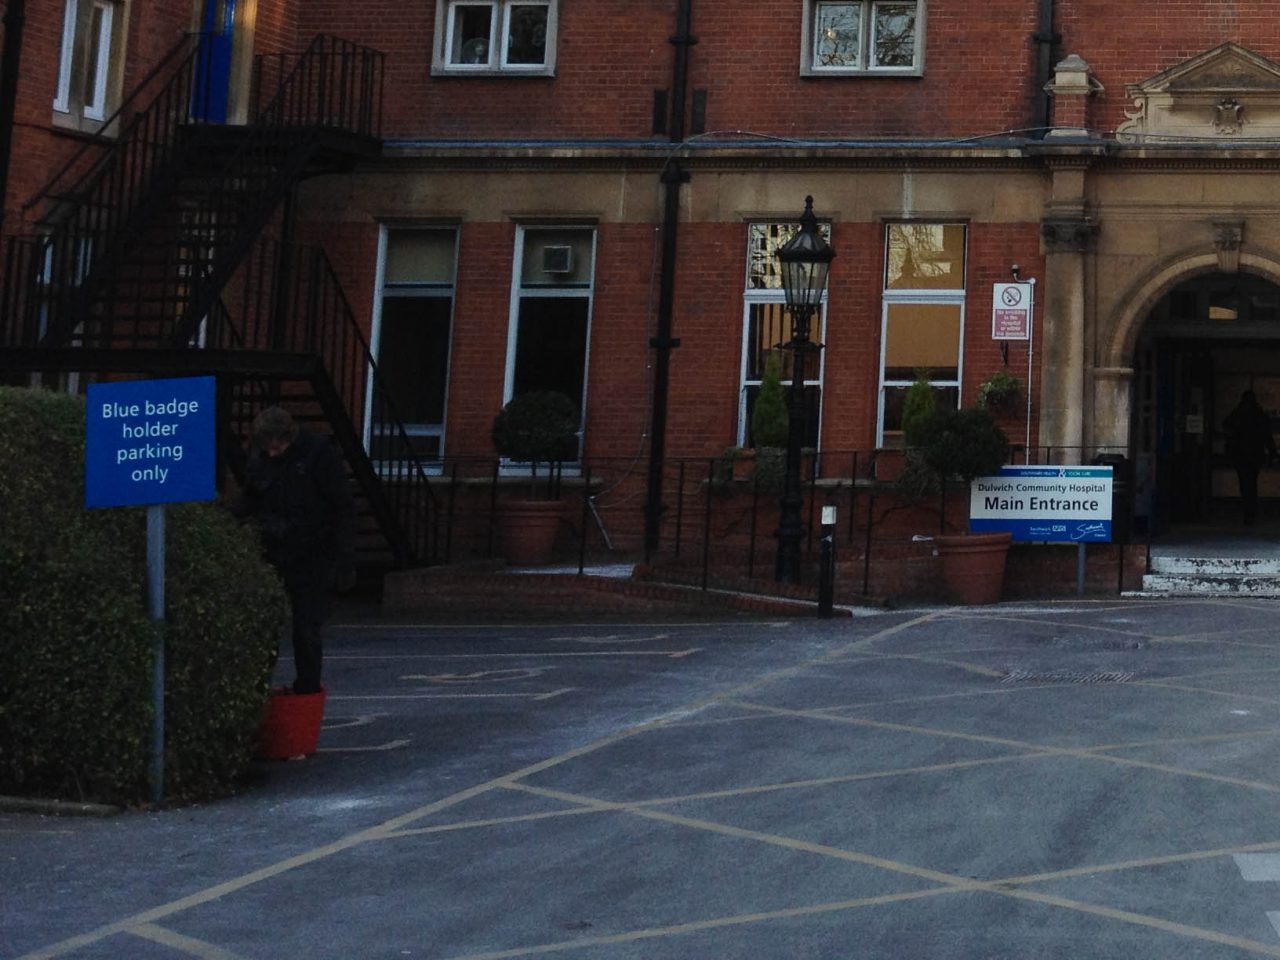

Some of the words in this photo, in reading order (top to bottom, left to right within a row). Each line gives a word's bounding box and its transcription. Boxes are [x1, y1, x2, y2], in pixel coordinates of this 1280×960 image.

[102, 402, 139, 418] Blue
[145, 398, 199, 417] badge
[123, 421, 178, 438] holder
[117, 443, 183, 464] parking
[131, 464, 168, 484] only
[978, 483, 1013, 492] Dulwich
[1016, 483, 1067, 494] Community
[1069, 484, 1106, 494] Hospital
[984, 496, 1023, 511] Main
[1029, 496, 1099, 511] Entrance
